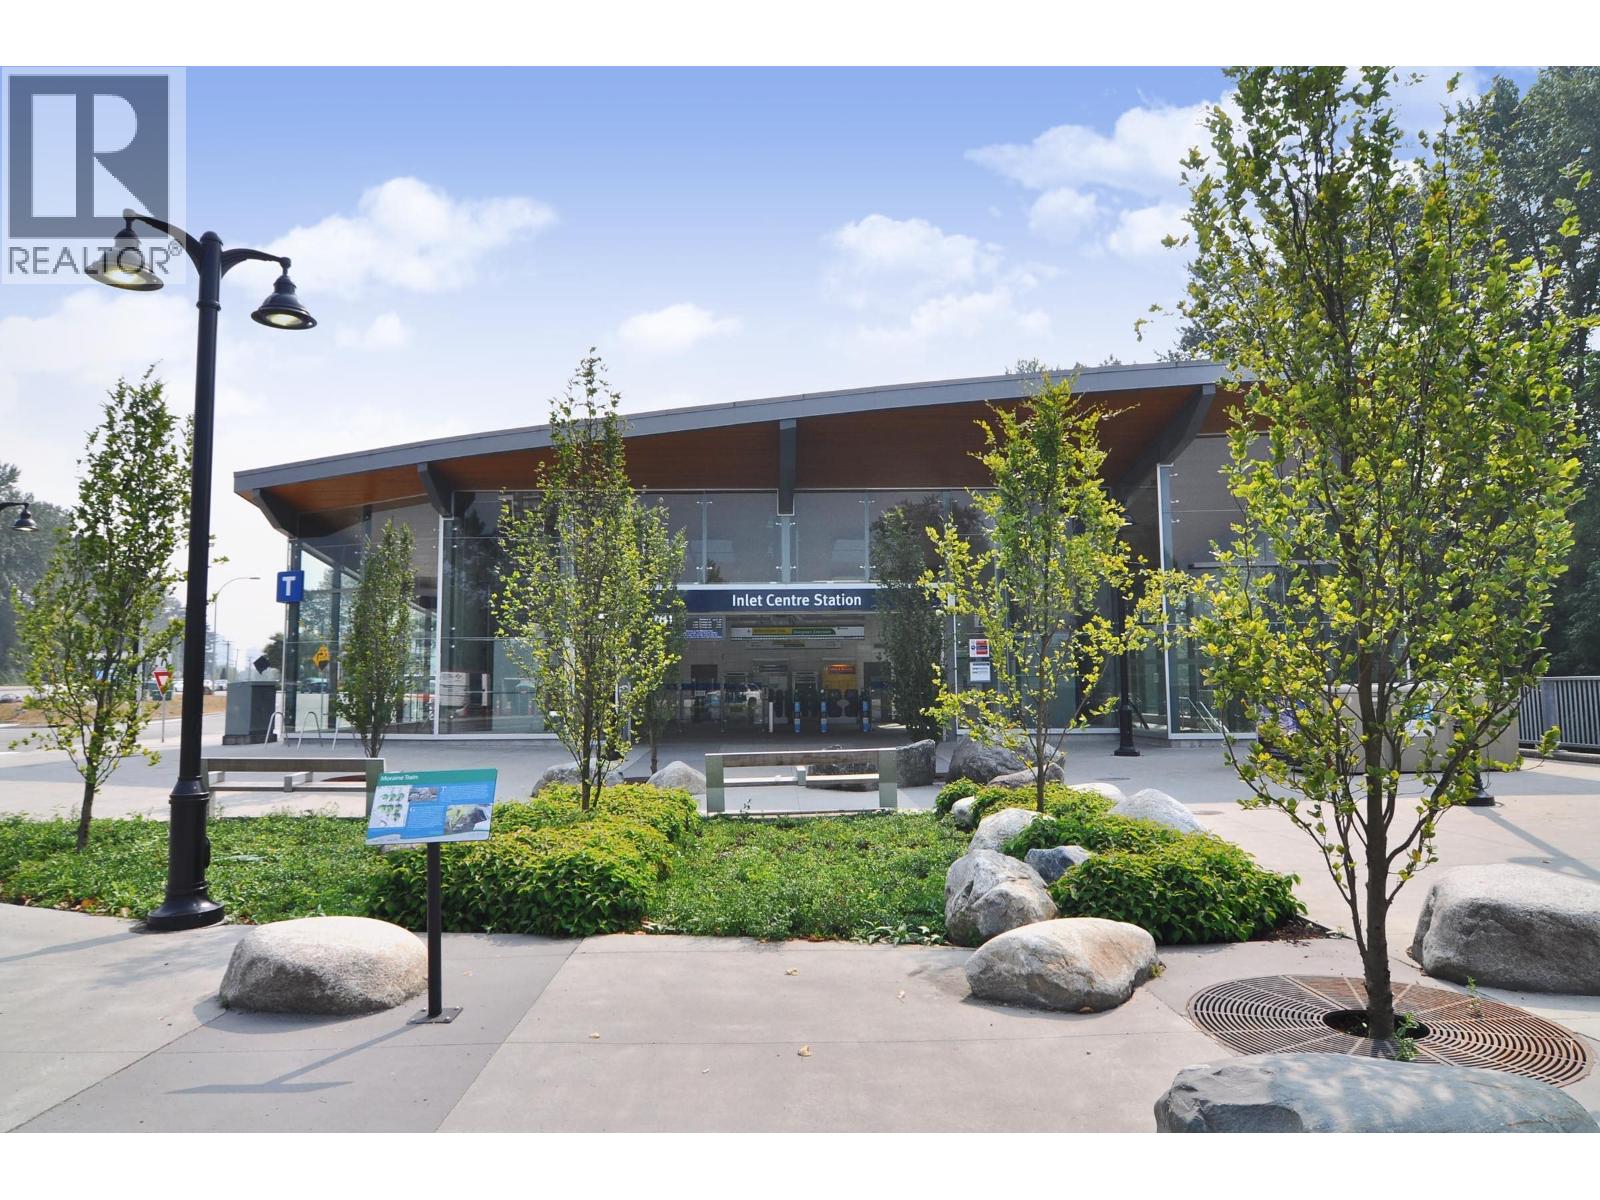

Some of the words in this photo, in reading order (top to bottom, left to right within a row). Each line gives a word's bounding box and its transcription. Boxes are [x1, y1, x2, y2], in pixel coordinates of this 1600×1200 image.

[282, 576, 296, 596] T
[732, 594, 763, 607] Inlet
[766, 594, 810, 606] Centre
[814, 593, 862, 606] Station
